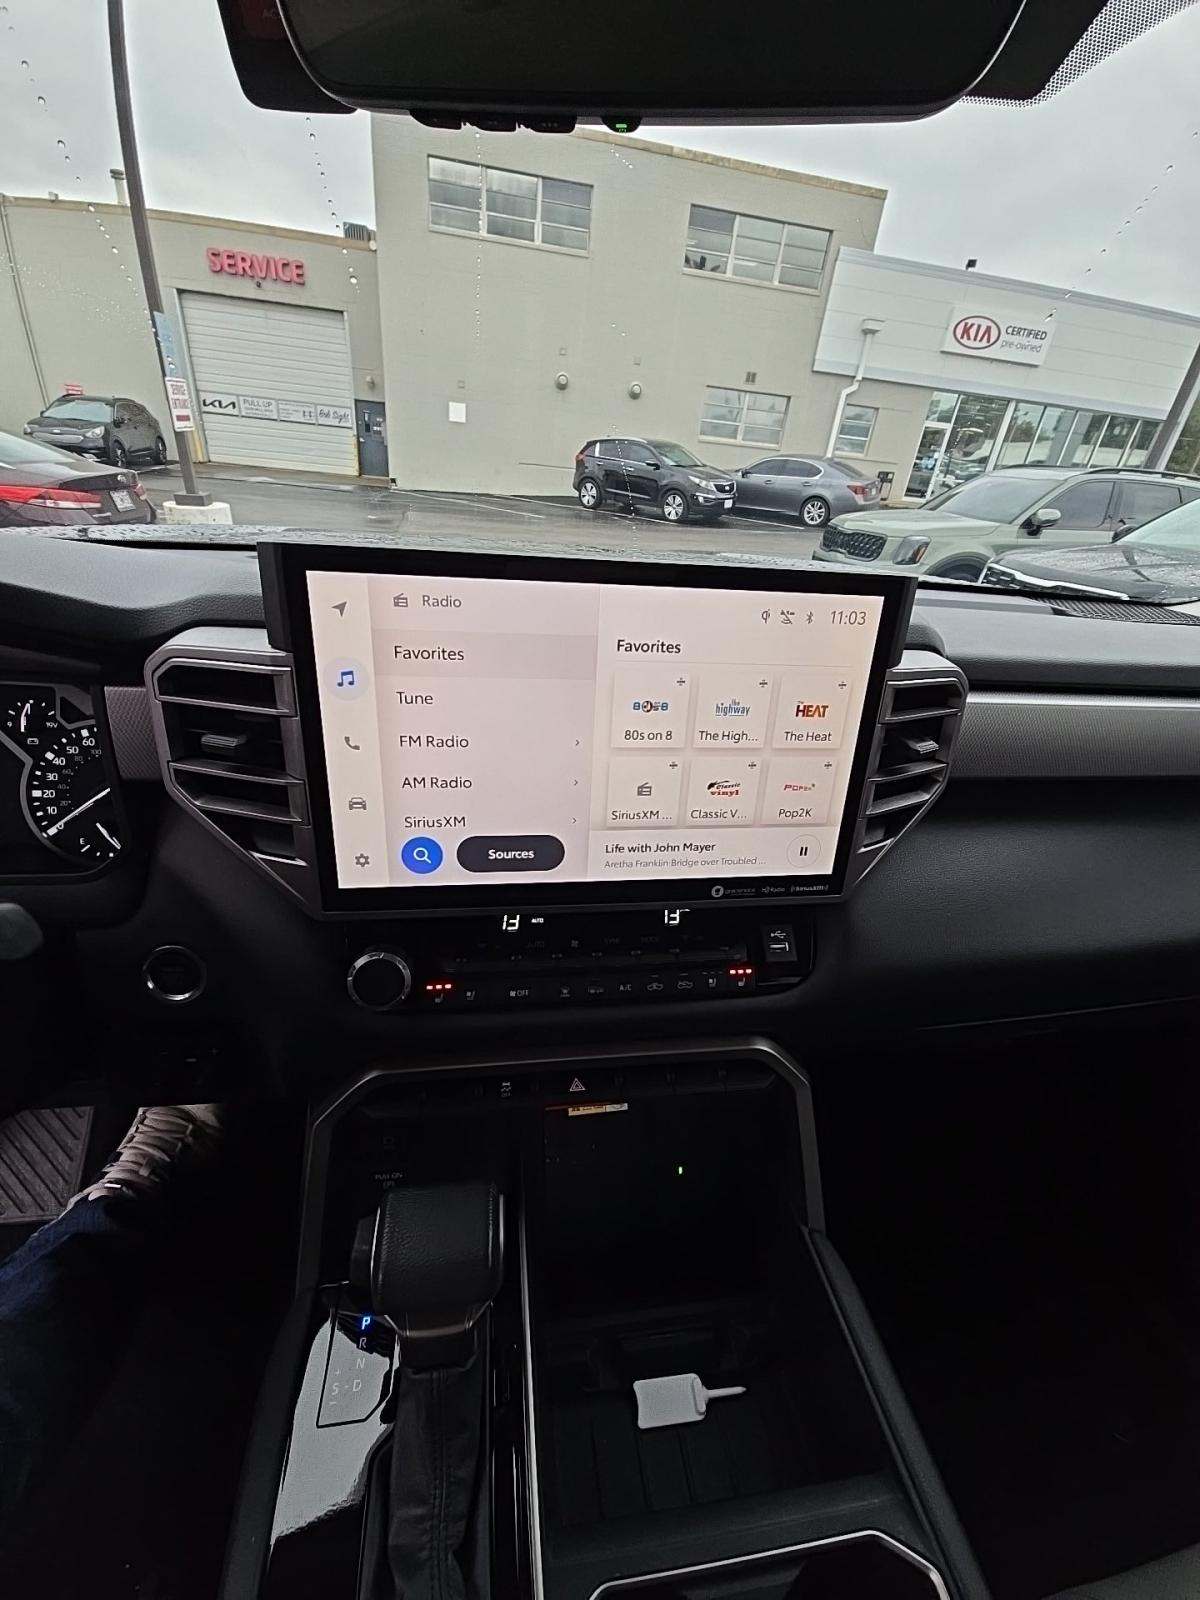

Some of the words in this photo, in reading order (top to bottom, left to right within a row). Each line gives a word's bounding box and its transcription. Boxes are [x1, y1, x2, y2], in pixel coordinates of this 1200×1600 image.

[206, 246, 306, 286] SERVICE
[960, 321, 992, 344] KIA
[1005, 325, 1047, 341] CERTIFIED
[1000, 340, 1042, 353] pre-owned
[422, 594, 462, 608] Radio
[830, 610, 867, 626] 11:03
[393, 645, 465, 661] Favorites
[616, 639, 681, 654] Favorites
[396, 691, 434, 705] Tune
[715, 703, 751, 717] highway
[795, 703, 829, 718] HEAT
[82, 738, 95, 746] 60
[399, 735, 422, 748] FM
[426, 735, 469, 748] Radio
[624, 730, 645, 741] 80s
[647, 732, 663, 741] on
[665, 730, 673, 741] 8
[699, 730, 719, 741] The
[784, 731, 804, 742] The
[806, 731, 832, 742] Heat
[66, 746, 79, 754] 50
[52, 757, 66, 765] 40
[45, 773, 58, 781] 30
[401, 777, 426, 789] AM
[430, 776, 472, 789] Radio
[43, 790, 55, 798] 20
[710, 788, 740, 797] vinyl
[690, 809, 728, 819] Classic
[778, 808, 813, 820] Pop2K
[404, 816, 467, 828] SiriusXM
[488, 848, 535, 860] Sources
[605, 843, 625, 854] Life
[627, 843, 652, 853] with
[653, 843, 680, 853] John
[683, 842, 716, 855] Mayer
[604, 860, 633, 869] Aretha
[635, 859, 669, 868] Franklin
[671, 858, 698, 869] Bridge
[721, 857, 757, 866] Troubled
[361, 1316, 371, 1330] P
[356, 1358, 366, 1369] N
[352, 1379, 362, 1392] D
